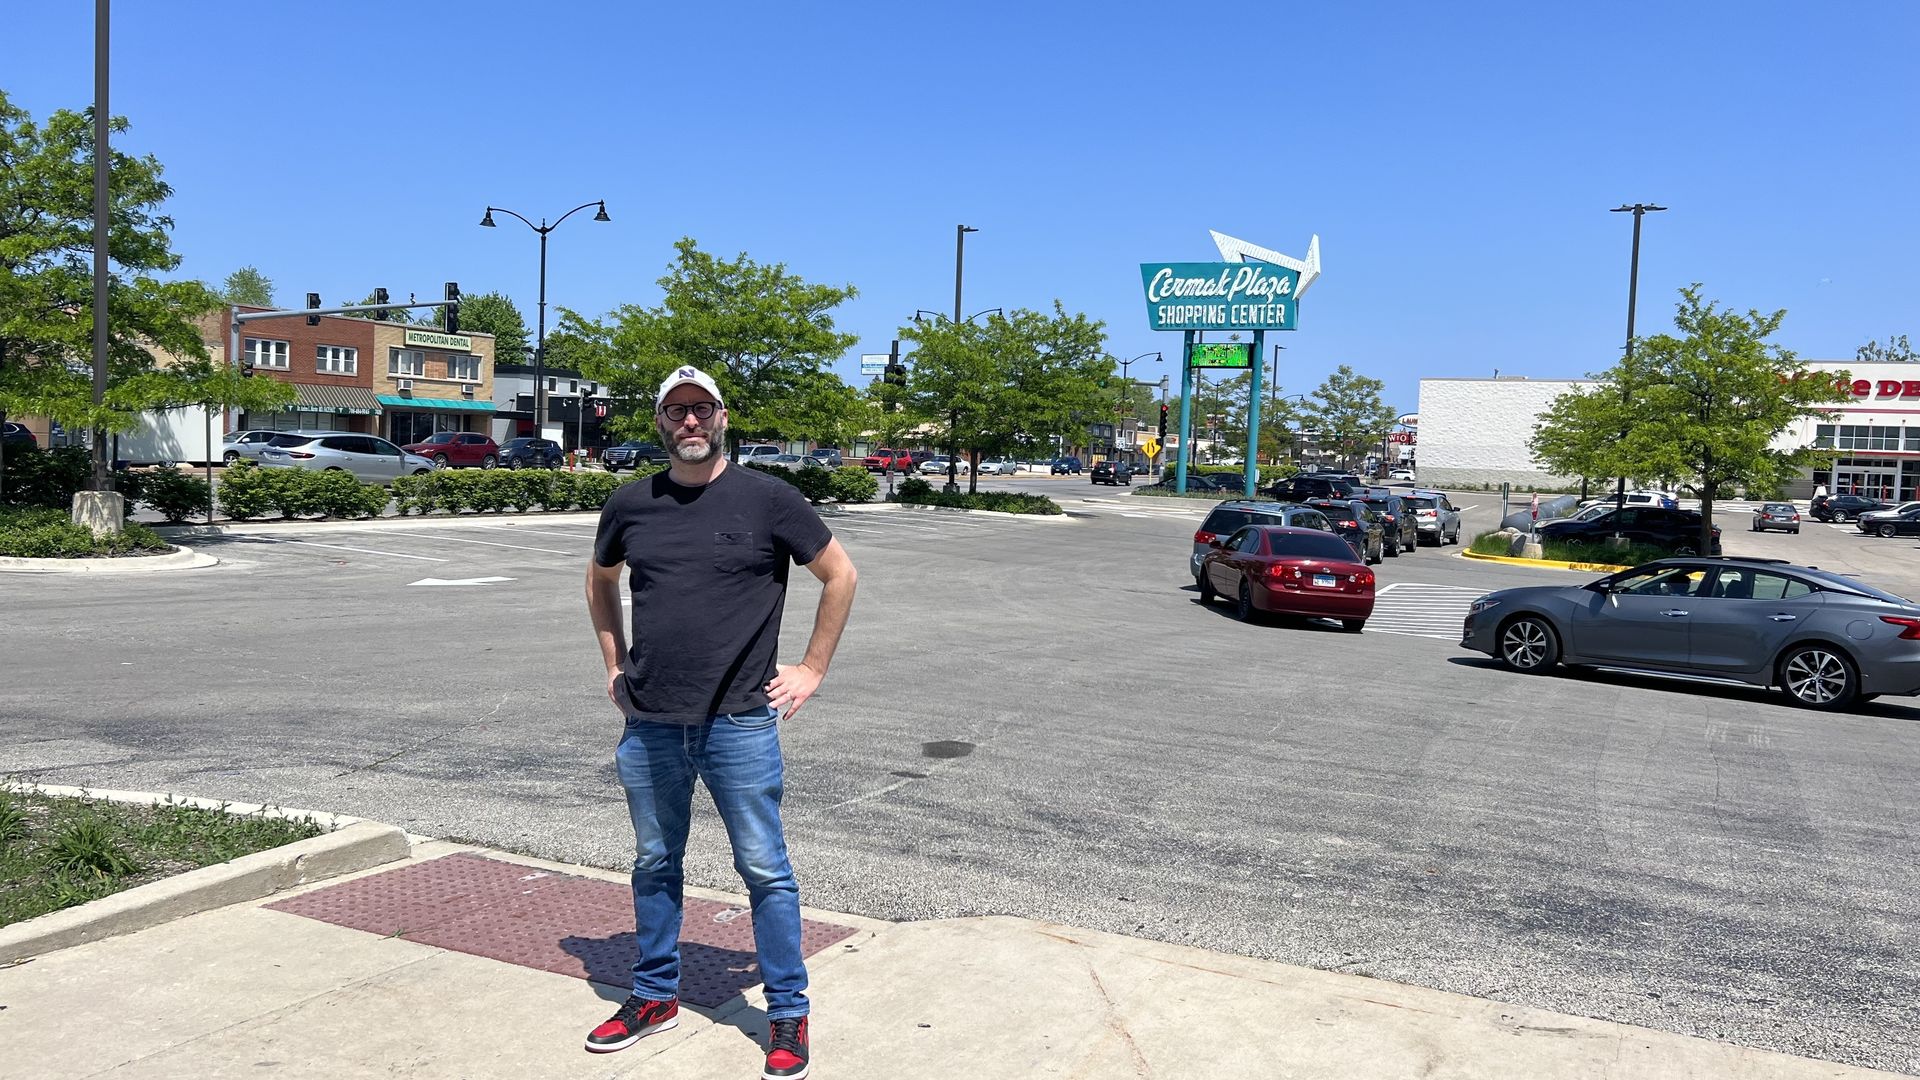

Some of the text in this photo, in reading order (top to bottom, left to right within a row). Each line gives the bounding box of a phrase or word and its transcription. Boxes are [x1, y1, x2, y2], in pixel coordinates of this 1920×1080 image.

[1148, 266, 1291, 305] Cermak Plaza
[1157, 303, 1285, 325] SHOPPING CENTER
[408, 332, 470, 348] METROPOLITAN DENTAL
[679, 369, 694, 378] N
